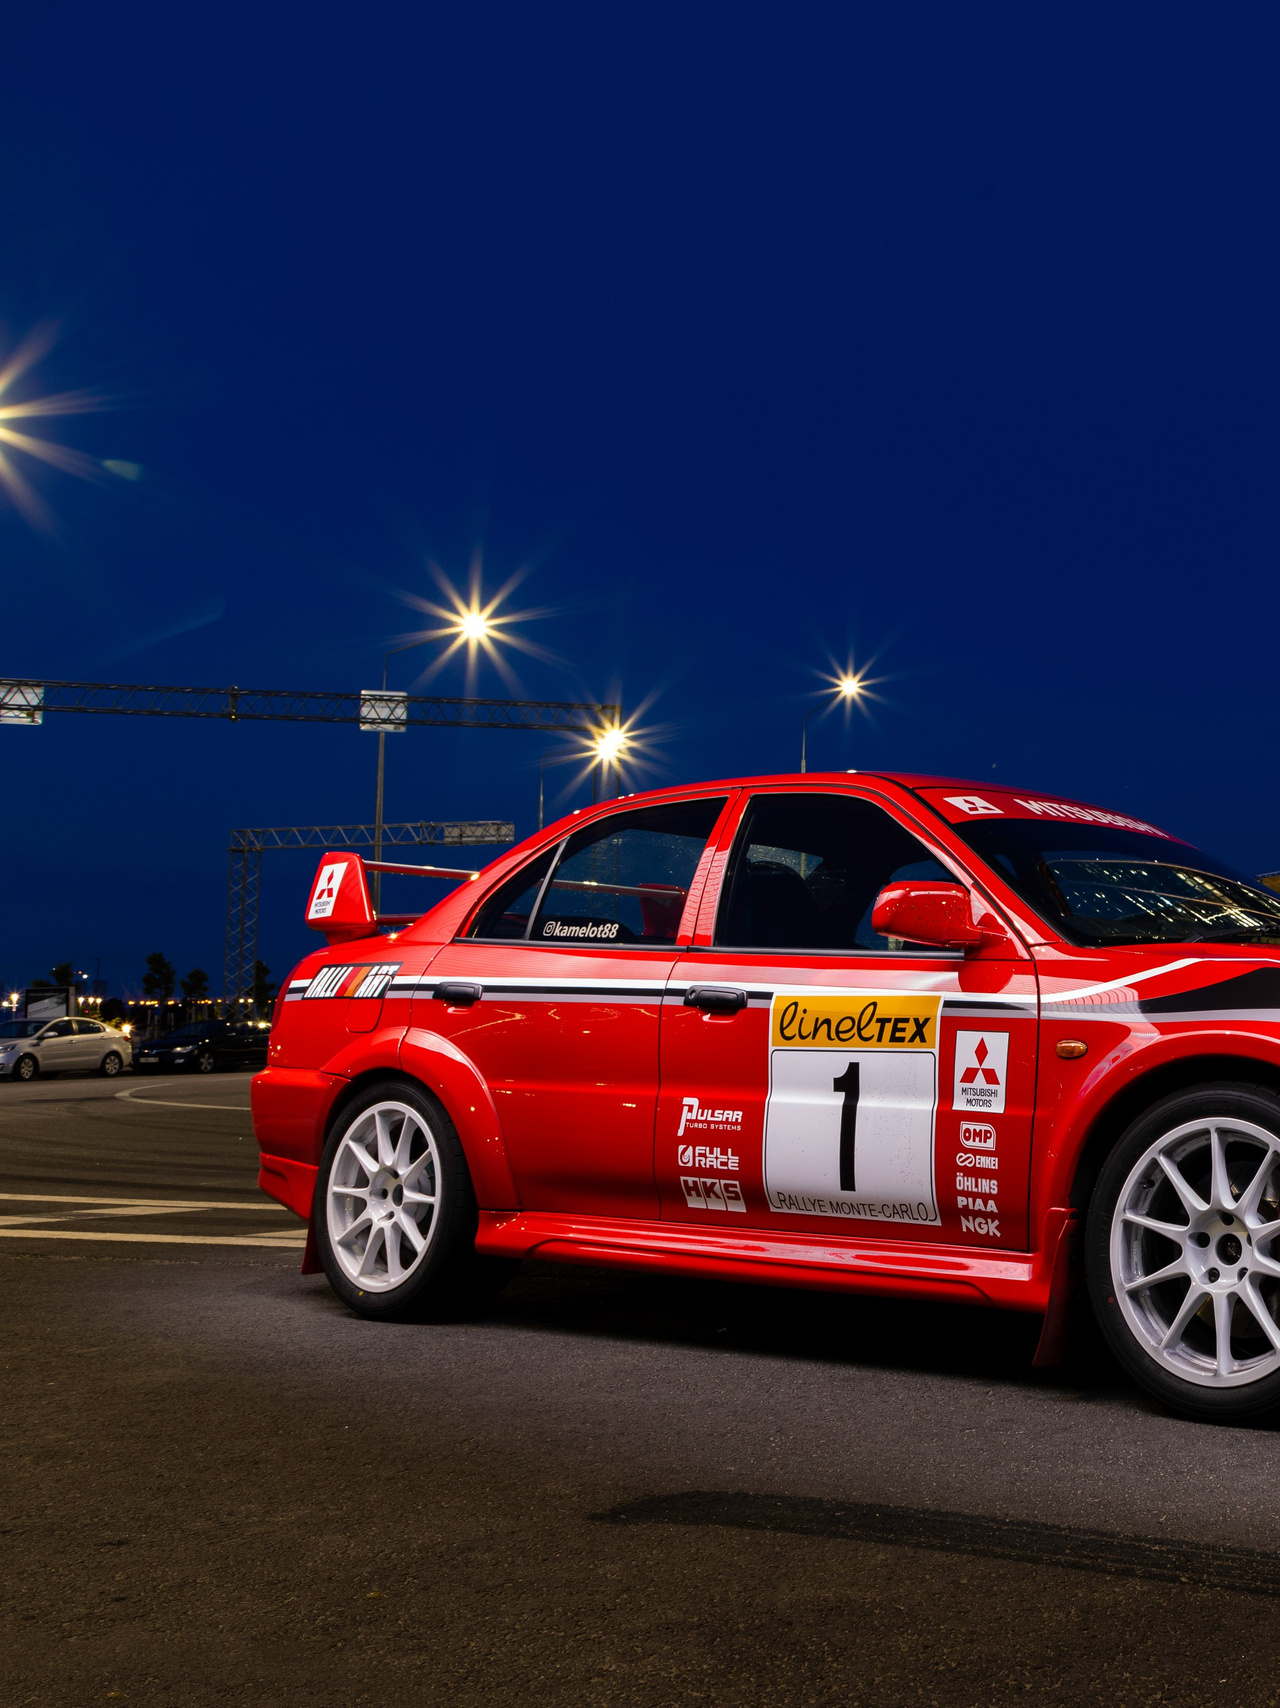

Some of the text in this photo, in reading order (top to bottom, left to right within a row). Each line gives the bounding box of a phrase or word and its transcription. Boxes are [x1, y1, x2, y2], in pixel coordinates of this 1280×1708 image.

[961, 1087, 998, 1098] MITSUBISHI
[965, 1098, 993, 1108] MOTORS
[686, 1122, 742, 1132] TURBO SYSTEMS
[833, 1061, 860, 1192] 1
[962, 1127, 993, 1144] OMP
[695, 1146, 739, 1160] FULL
[695, 1156, 739, 1171] RACE
[975, 1155, 999, 1170] ENKEI
[681, 1178, 742, 1202] HKS
[956, 1172, 998, 1195] ÖHLINS
[775, 1191, 929, 1222] RALLYE MONTE-CARLO
[957, 1196, 999, 1213] PIAA
[960, 1215, 1002, 1238] NGK
